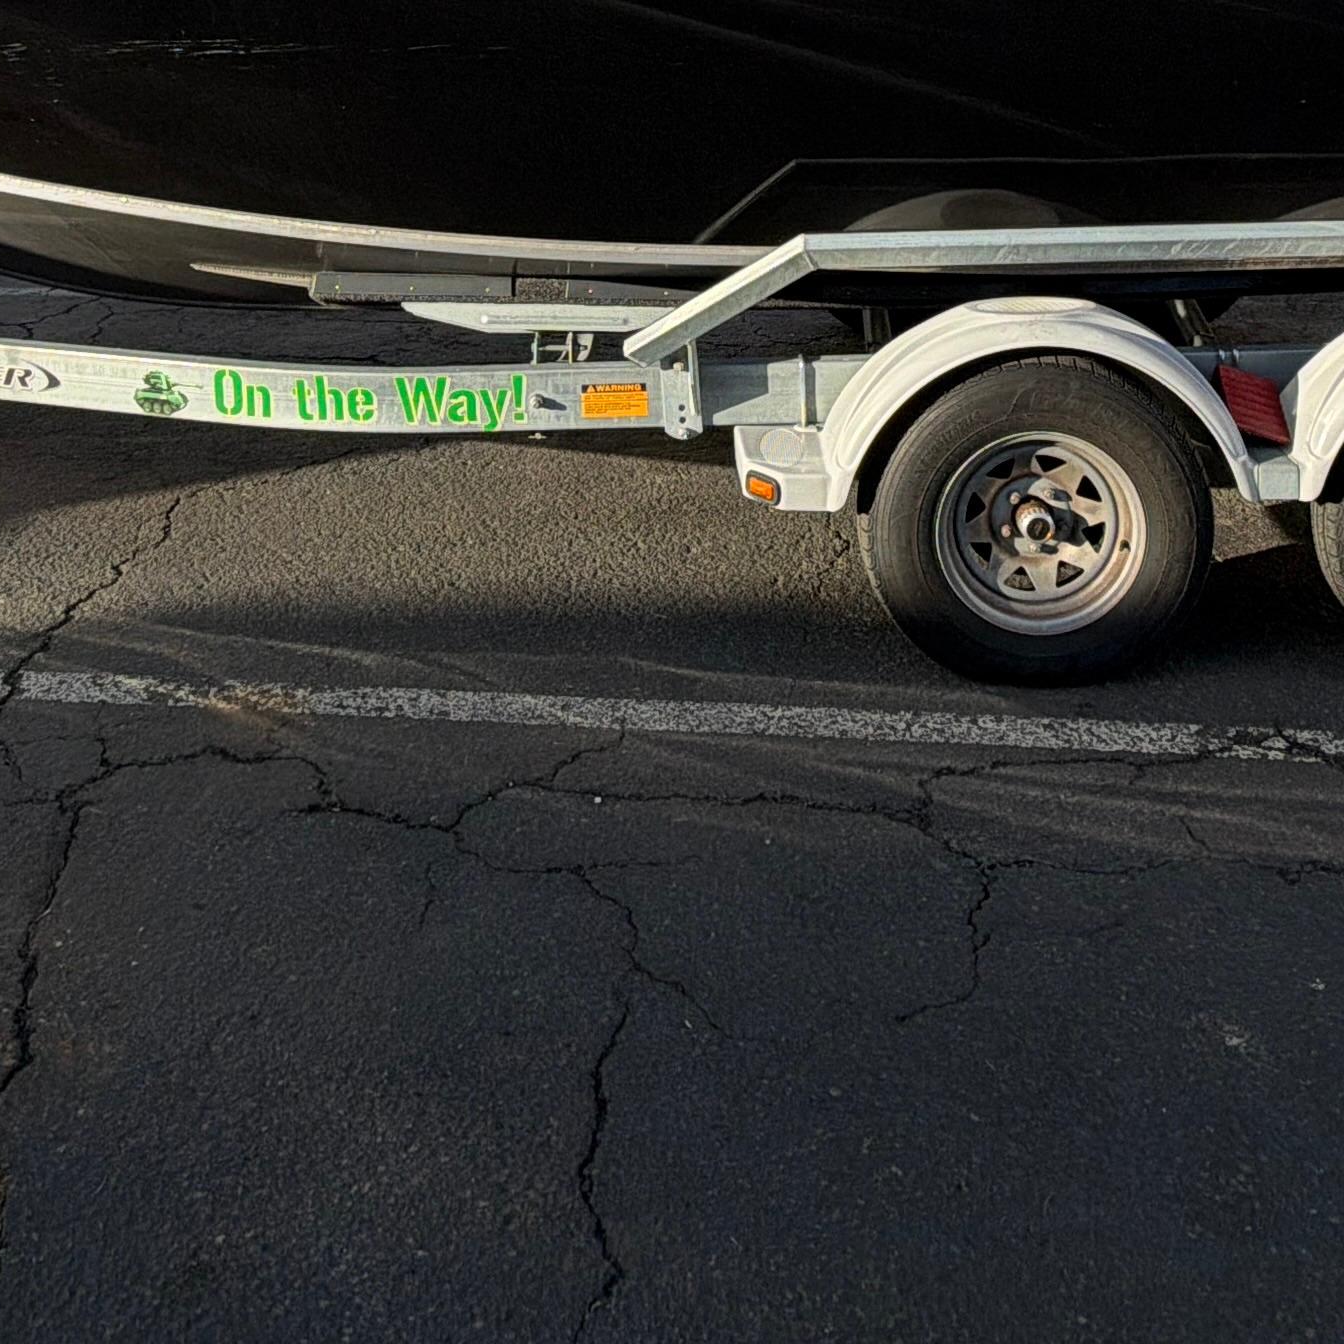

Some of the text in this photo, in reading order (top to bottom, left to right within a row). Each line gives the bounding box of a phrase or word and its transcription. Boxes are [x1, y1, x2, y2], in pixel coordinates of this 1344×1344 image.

[213, 368, 272, 418] On
[292, 374, 376, 423] the
[394, 373, 527, 432] Way!
[596, 384, 642, 392] WARNING
